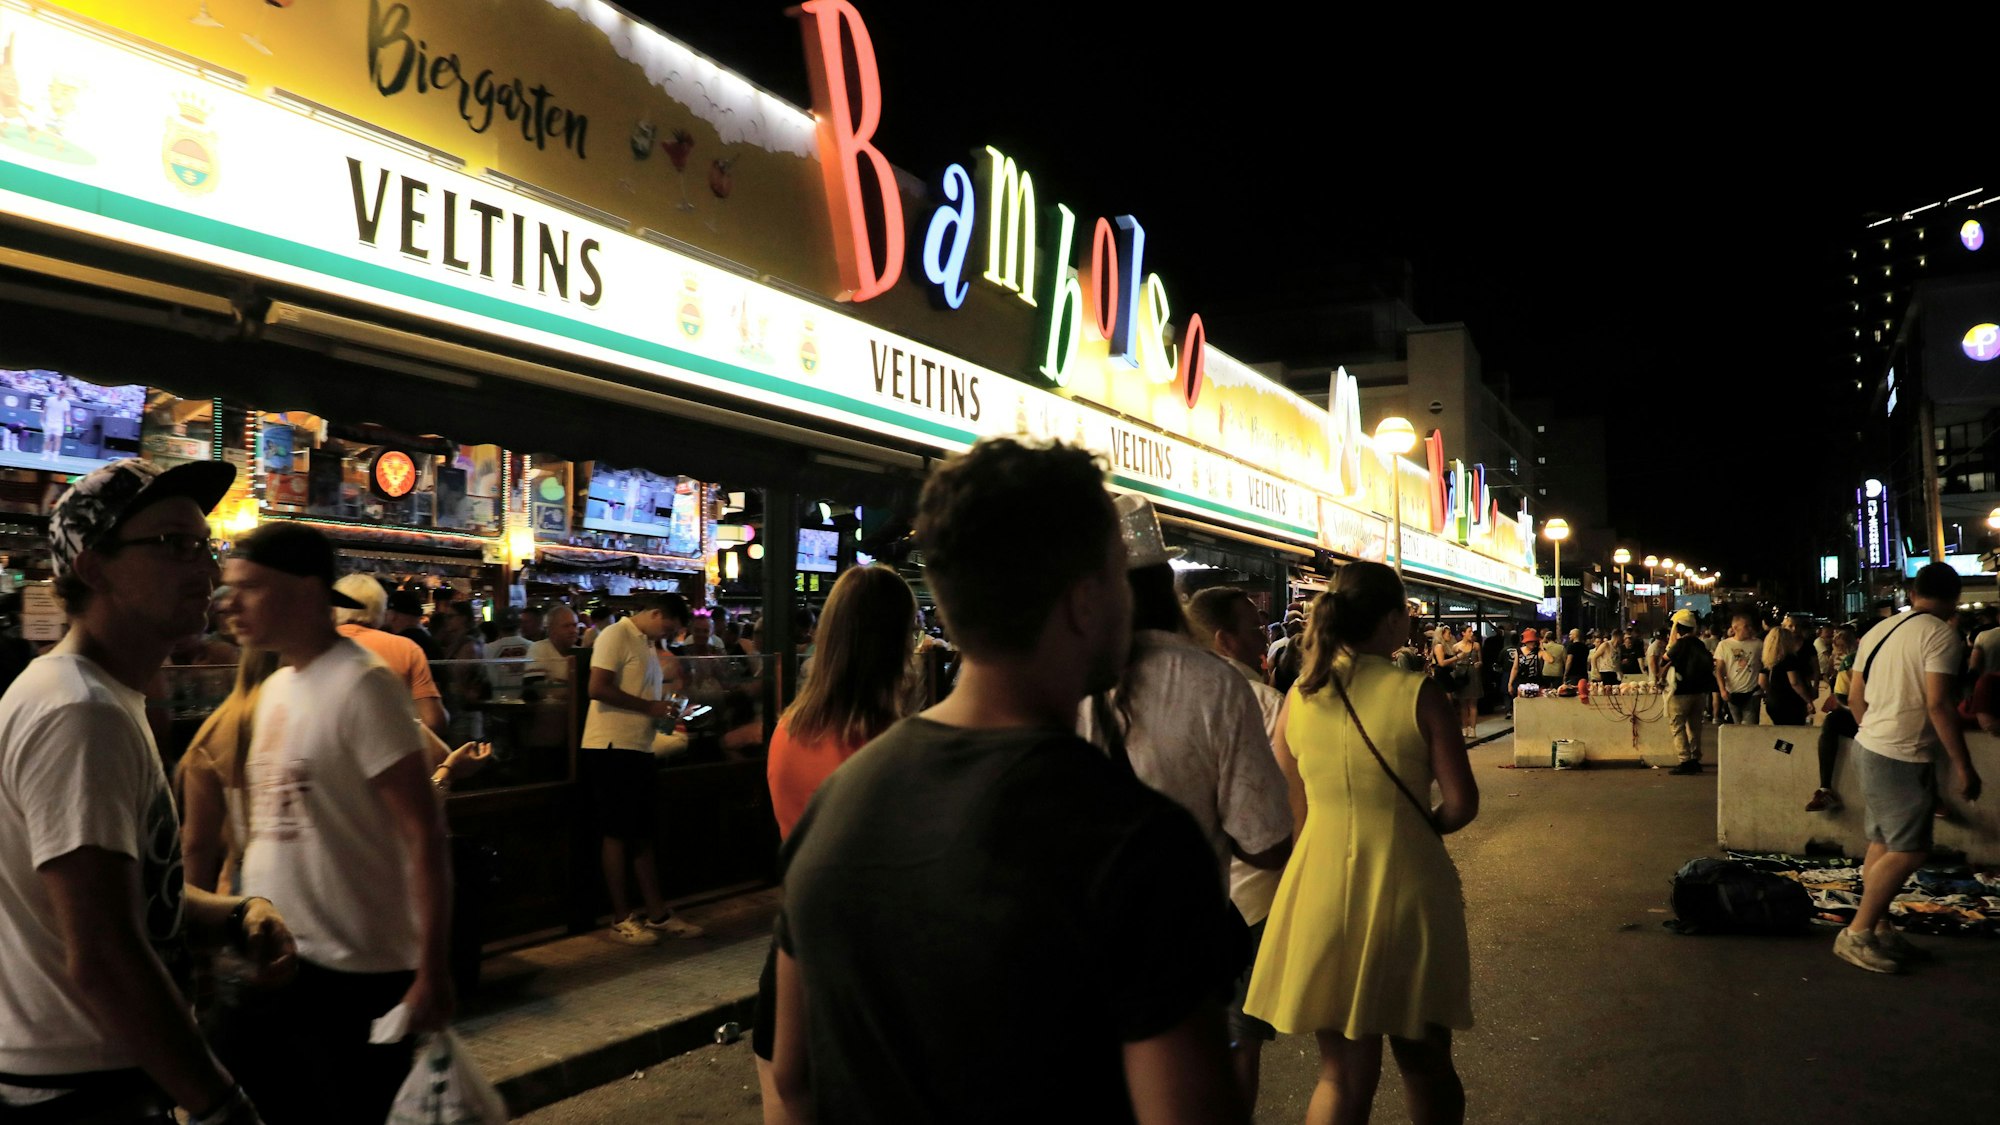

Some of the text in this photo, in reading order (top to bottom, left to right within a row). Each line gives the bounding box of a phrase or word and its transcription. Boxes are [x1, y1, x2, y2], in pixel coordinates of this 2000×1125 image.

[367, 0, 589, 160] Biergarten
[346, 156, 604, 308] VELTINS
[800, 0, 1205, 409] Bamboleo
[870, 338, 982, 423] VELTINS
[1110, 427, 1172, 480] VELTINS
[1248, 475, 1287, 516] VELTINS
[1543, 574, 1581, 587] Bihaus
